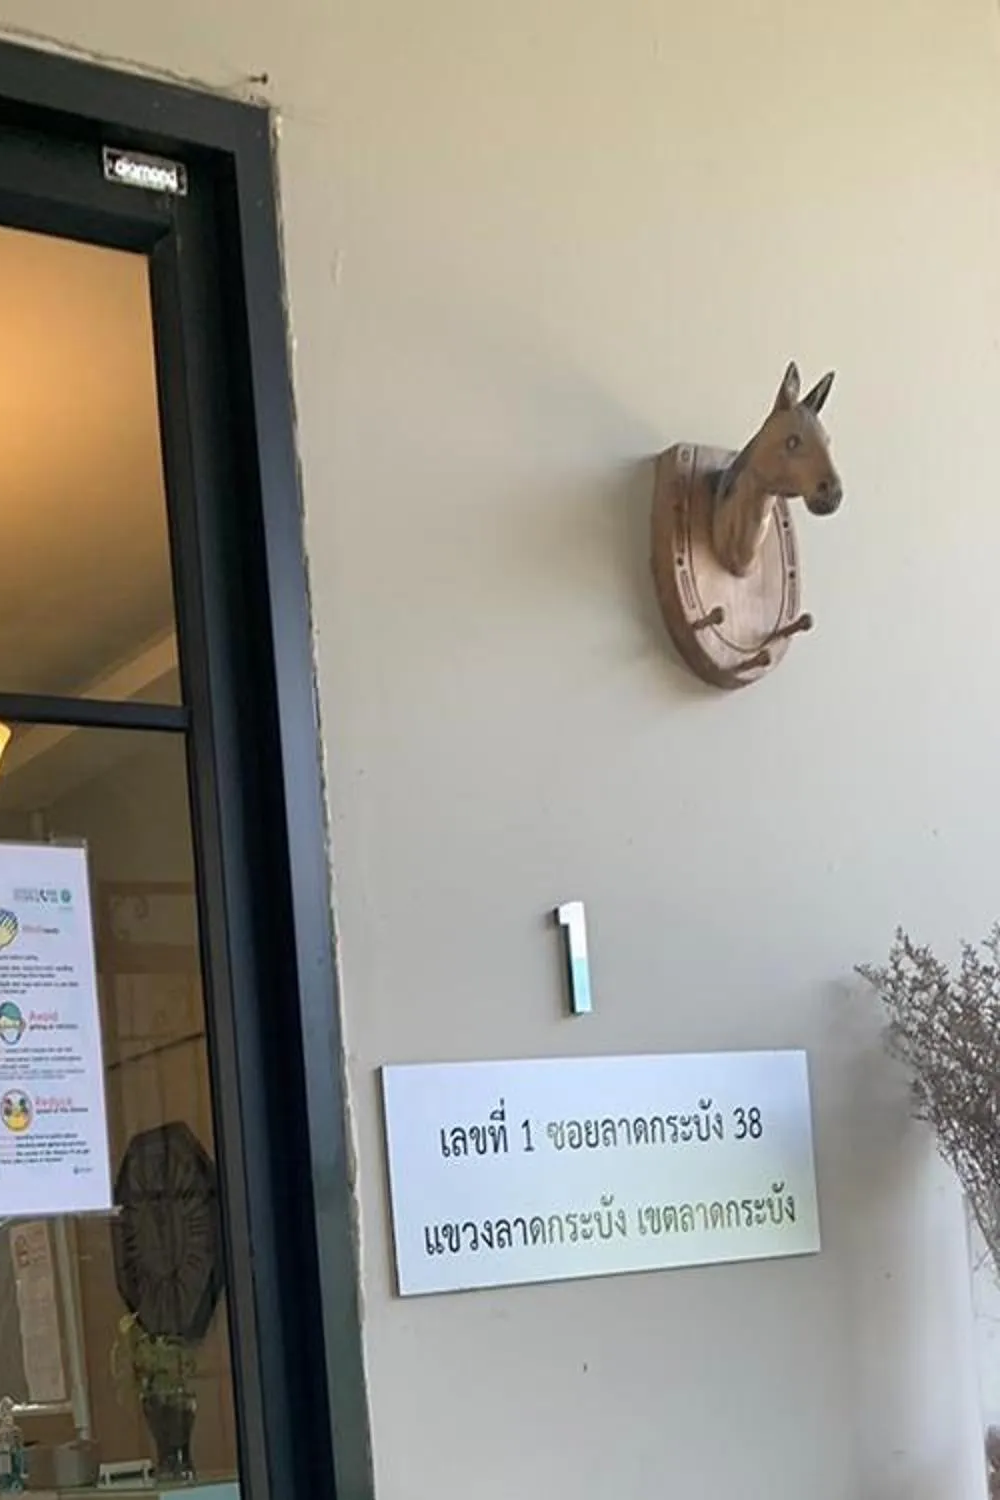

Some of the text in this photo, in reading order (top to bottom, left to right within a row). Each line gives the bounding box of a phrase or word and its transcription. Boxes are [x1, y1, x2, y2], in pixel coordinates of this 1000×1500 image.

[556, 900, 593, 1014] 1
[440, 1098, 763, 1157] เลขที่ 1 ซอยลาดกระบัง 38
[424, 1182, 796, 1255] แขวงลาดกระบัง เขตลาดกระบัง
